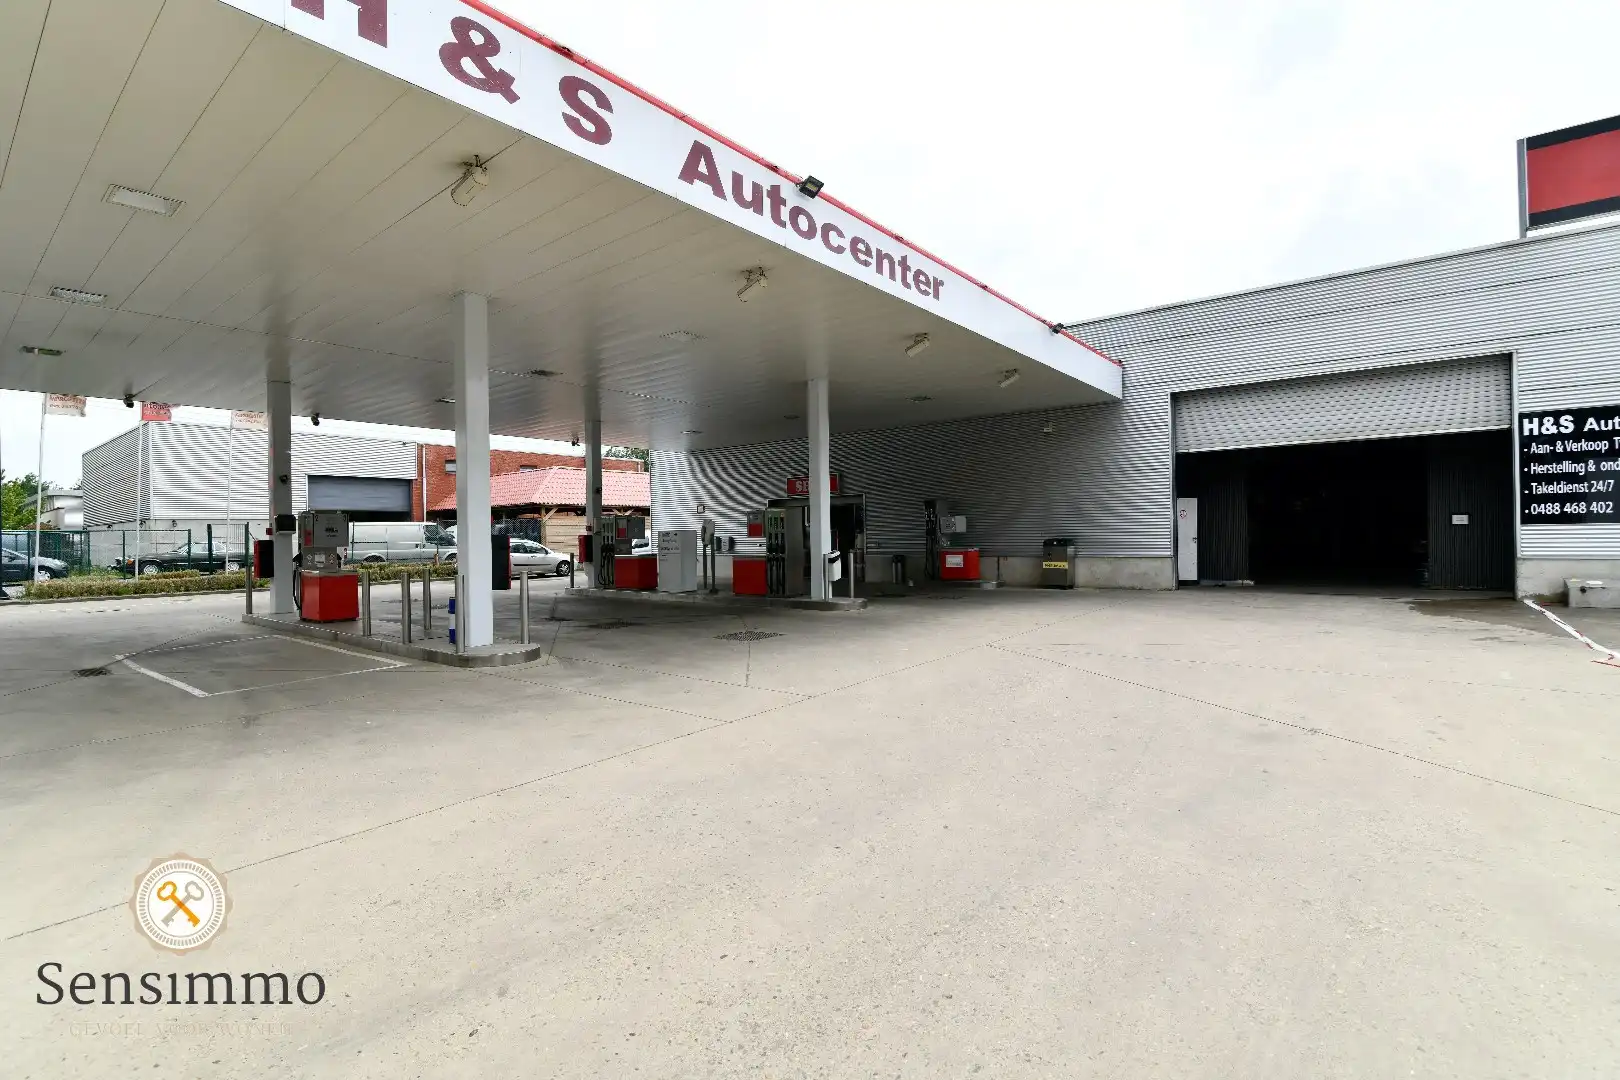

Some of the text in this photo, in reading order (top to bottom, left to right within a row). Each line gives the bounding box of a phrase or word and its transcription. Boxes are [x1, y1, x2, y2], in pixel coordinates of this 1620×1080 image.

[438, 16, 520, 104] &
[558, 75, 614, 146] S
[678, 140, 945, 302] Autocenter
[1523, 415, 1575, 435] H&S
[1530, 443, 1554, 454] Aan-
[1564, 438, 1609, 454] Verkoop
[1530, 460, 1586, 476] Herstelling
[1587, 459, 1596, 472] &
[1530, 479, 1615, 495] Takeldienst 24/7
[1530, 501, 1614, 515] 0488 468 402
